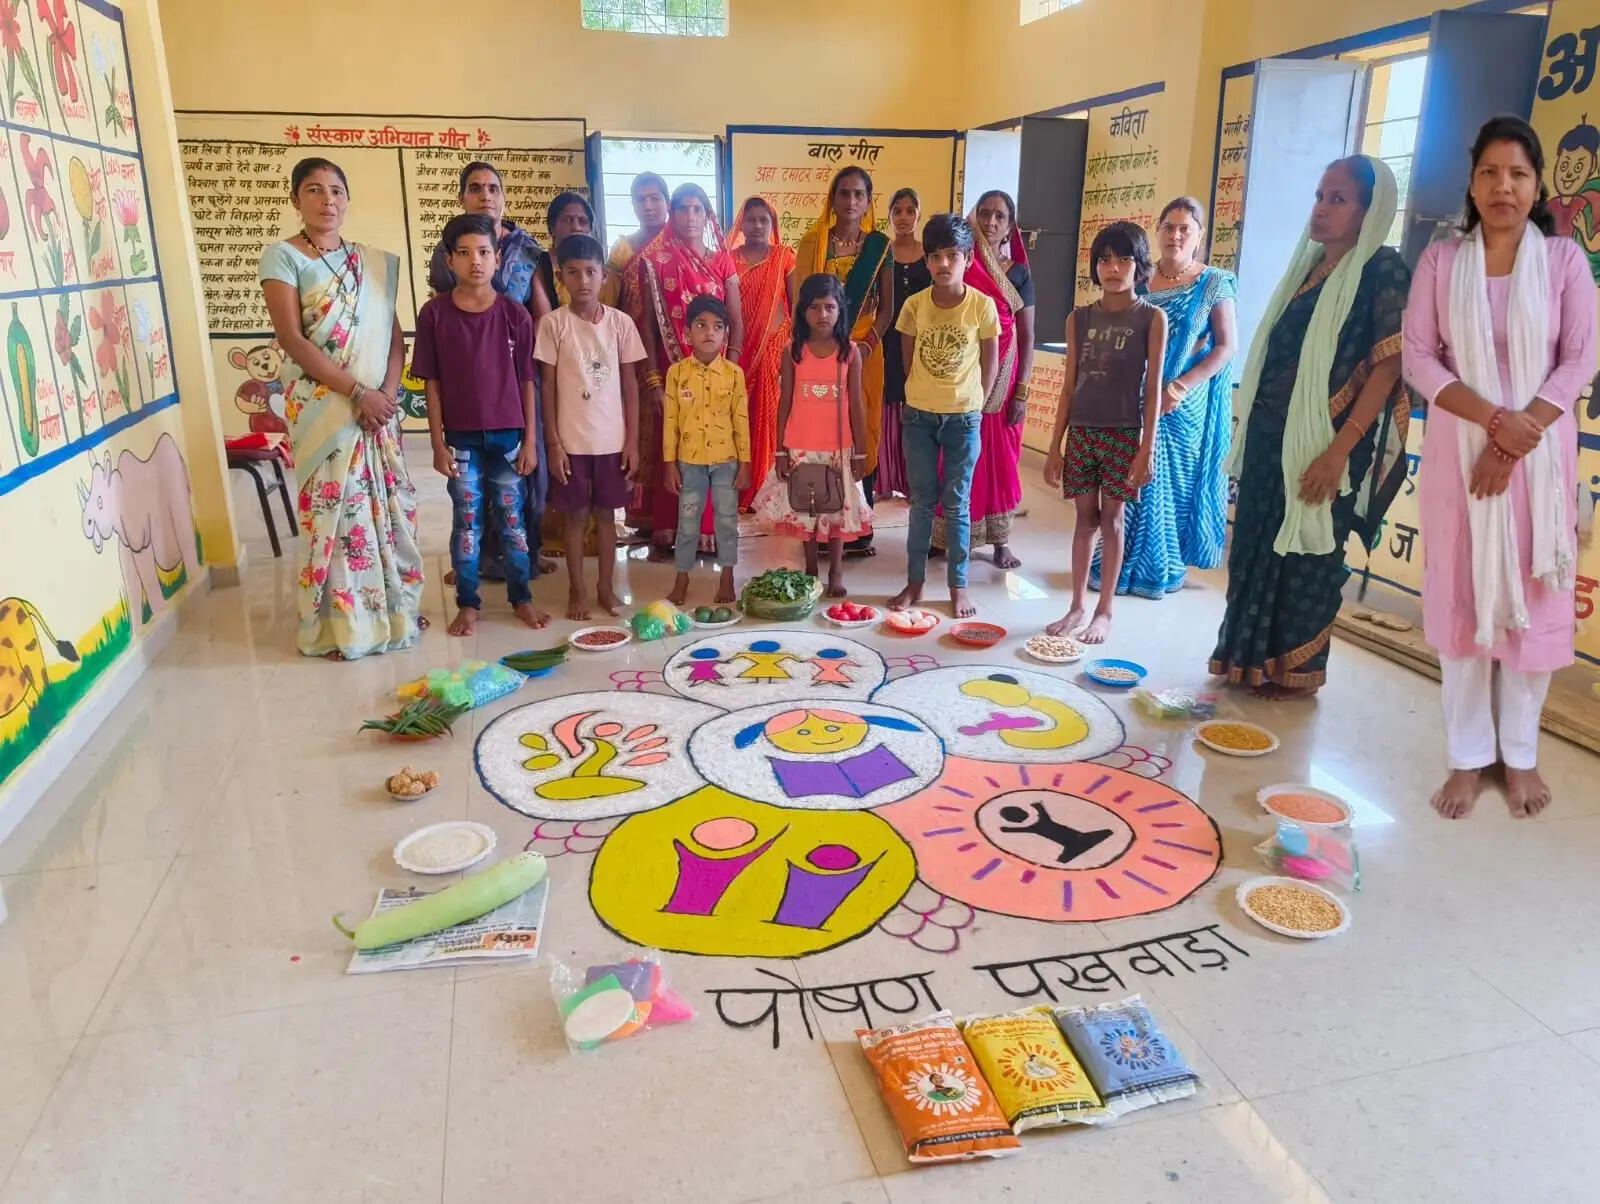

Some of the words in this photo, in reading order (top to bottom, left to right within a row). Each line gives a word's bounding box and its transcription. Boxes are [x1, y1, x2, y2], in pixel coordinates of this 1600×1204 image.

[1538, 25, 1600, 101] अ
[1109, 106, 1149, 140] कविता
[306, 124, 365, 146] संस्कार
[369, 126, 433, 147] अभियान
[439, 127, 470, 148] गीत
[202, 143, 222, 155] लिया
[225, 143, 232, 158] है
[807, 143, 845, 163] बाल
[848, 138, 885, 165] गीत
[782, 167, 814, 183] टमाटर
[266, 208, 280, 221] की
[266, 224, 280, 237] की
[1389, 523, 1419, 563] ज
[705, 967, 942, 1048] पोषण
